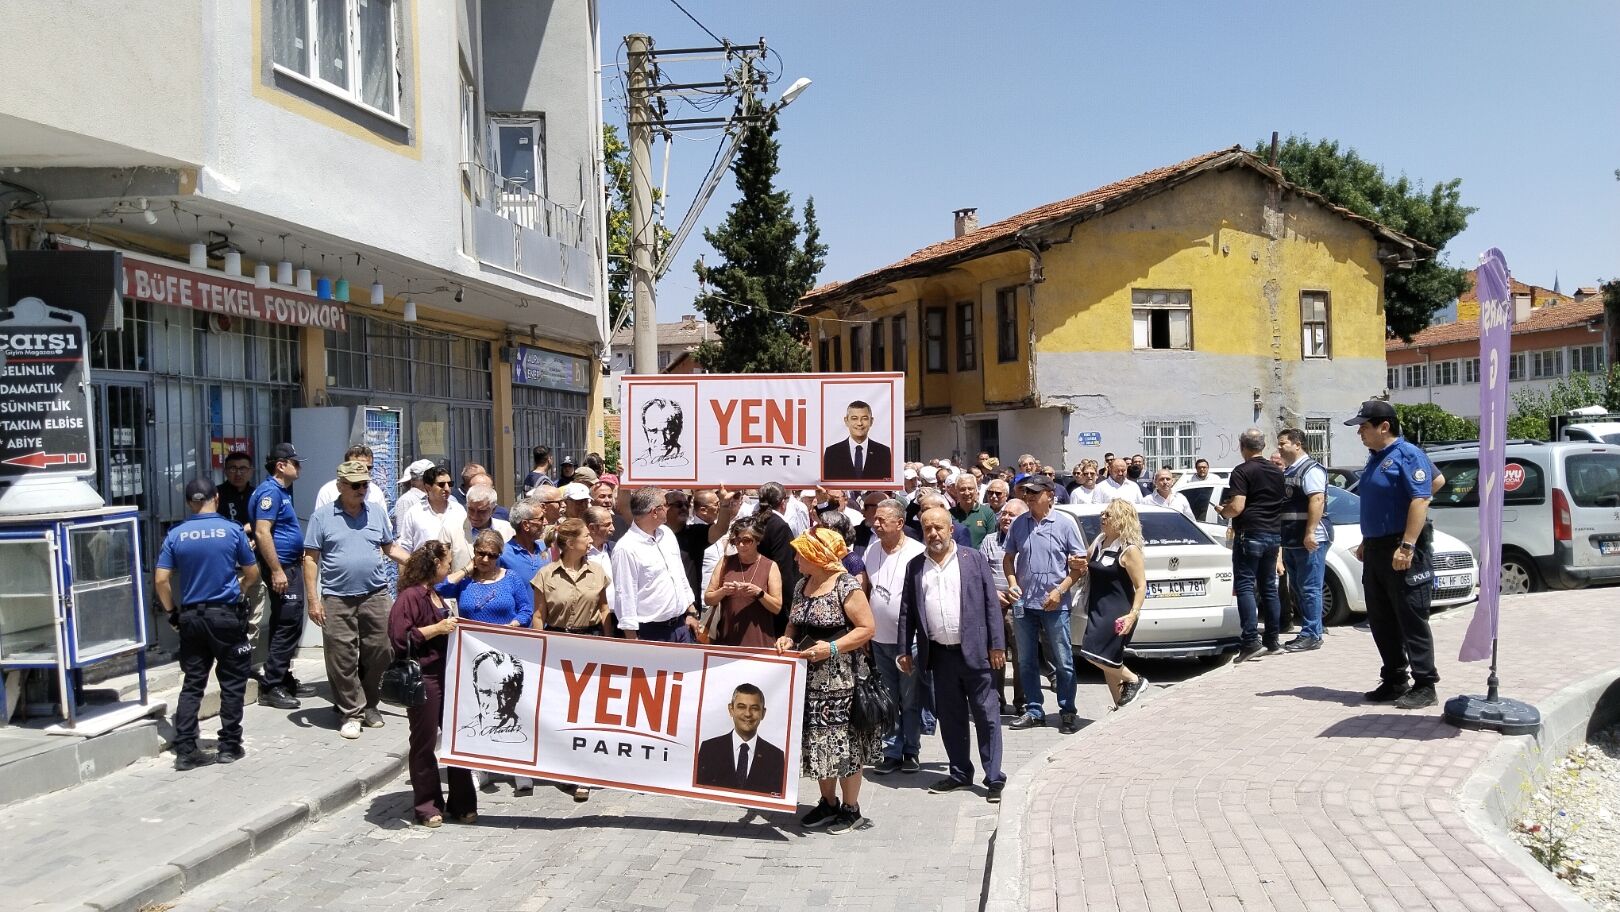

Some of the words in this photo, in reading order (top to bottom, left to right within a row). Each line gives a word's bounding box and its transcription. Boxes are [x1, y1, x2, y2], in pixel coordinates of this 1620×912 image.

[135, 269, 192, 306] BÜFE
[198, 282, 260, 318] TEKEL
[264, 295, 347, 330] FOTOKOPİ
[0, 383, 63, 394] DAMATLIK
[1, 399, 71, 412] SÜNNETLİK
[45, 416, 84, 429] ELBİSE
[7, 436, 43, 448] ABİYE
[1151, 583, 1162, 593] 64
[1169, 582, 1185, 592] ACN
[1188, 581, 1204, 591] 781
